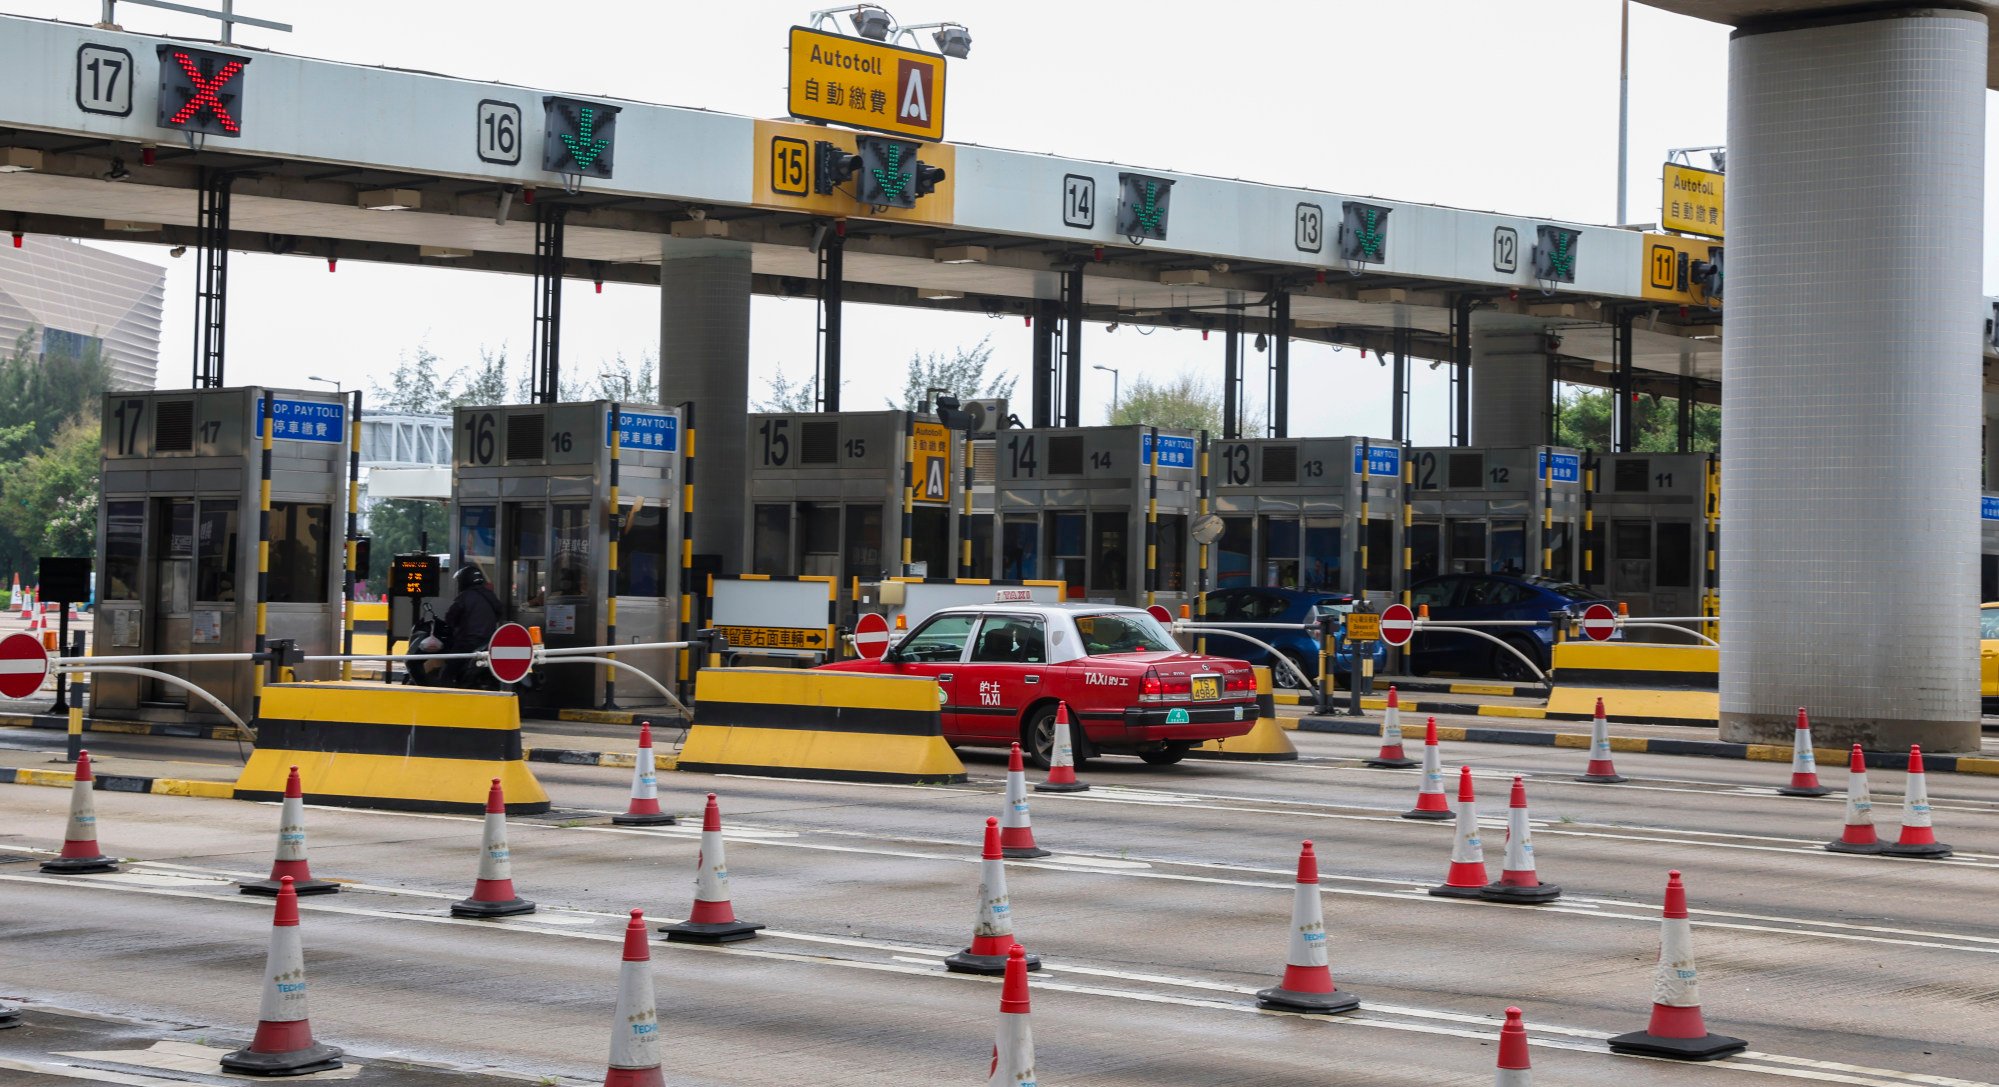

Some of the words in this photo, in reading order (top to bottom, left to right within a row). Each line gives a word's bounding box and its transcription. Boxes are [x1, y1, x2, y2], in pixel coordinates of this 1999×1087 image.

[810, 44, 882, 76] Autotoll
[87, 57, 123, 102] 17
[805, 78, 887, 115] 自動繳費
[485, 112, 515, 154] 16
[778, 147, 802, 186] 15
[1673, 175, 1714, 196] Autotoll
[1069, 183, 1090, 219] 14
[1299, 212, 1318, 244] 13
[1497, 235, 1514, 265] 12
[1656, 254, 1671, 281] 11
[294, 405, 314, 416] PAY
[316, 406, 341, 418] TOLL
[114, 400, 143, 456] 17
[200, 420, 221, 444] 17
[273, 419, 328, 437] 停車繳費
[636, 417, 652, 428] PAY
[654, 418, 675, 430] TOLL
[464, 412, 496, 465] 16
[551, 431, 573, 453] 16
[759, 419, 789, 466] 15
[844, 438, 865, 458] 15
[1164, 439, 1177, 448] PAY
[1008, 434, 1037, 478] 14
[1090, 451, 1112, 469] 14
[1222, 443, 1250, 485] 13
[1303, 460, 1324, 477] 13
[1412, 451, 1437, 490] 12
[1489, 467, 1509, 483] 12
[1655, 472, 1673, 488] 11
[1003, 590, 1031, 600] TAXI
[979, 681, 1001, 693] 的士
[1085, 672, 1107, 686] TAXI
[1200, 680, 1210, 689] TS
[980, 693, 1001, 706] TAXI
[1194, 688, 1216, 699] 4982
